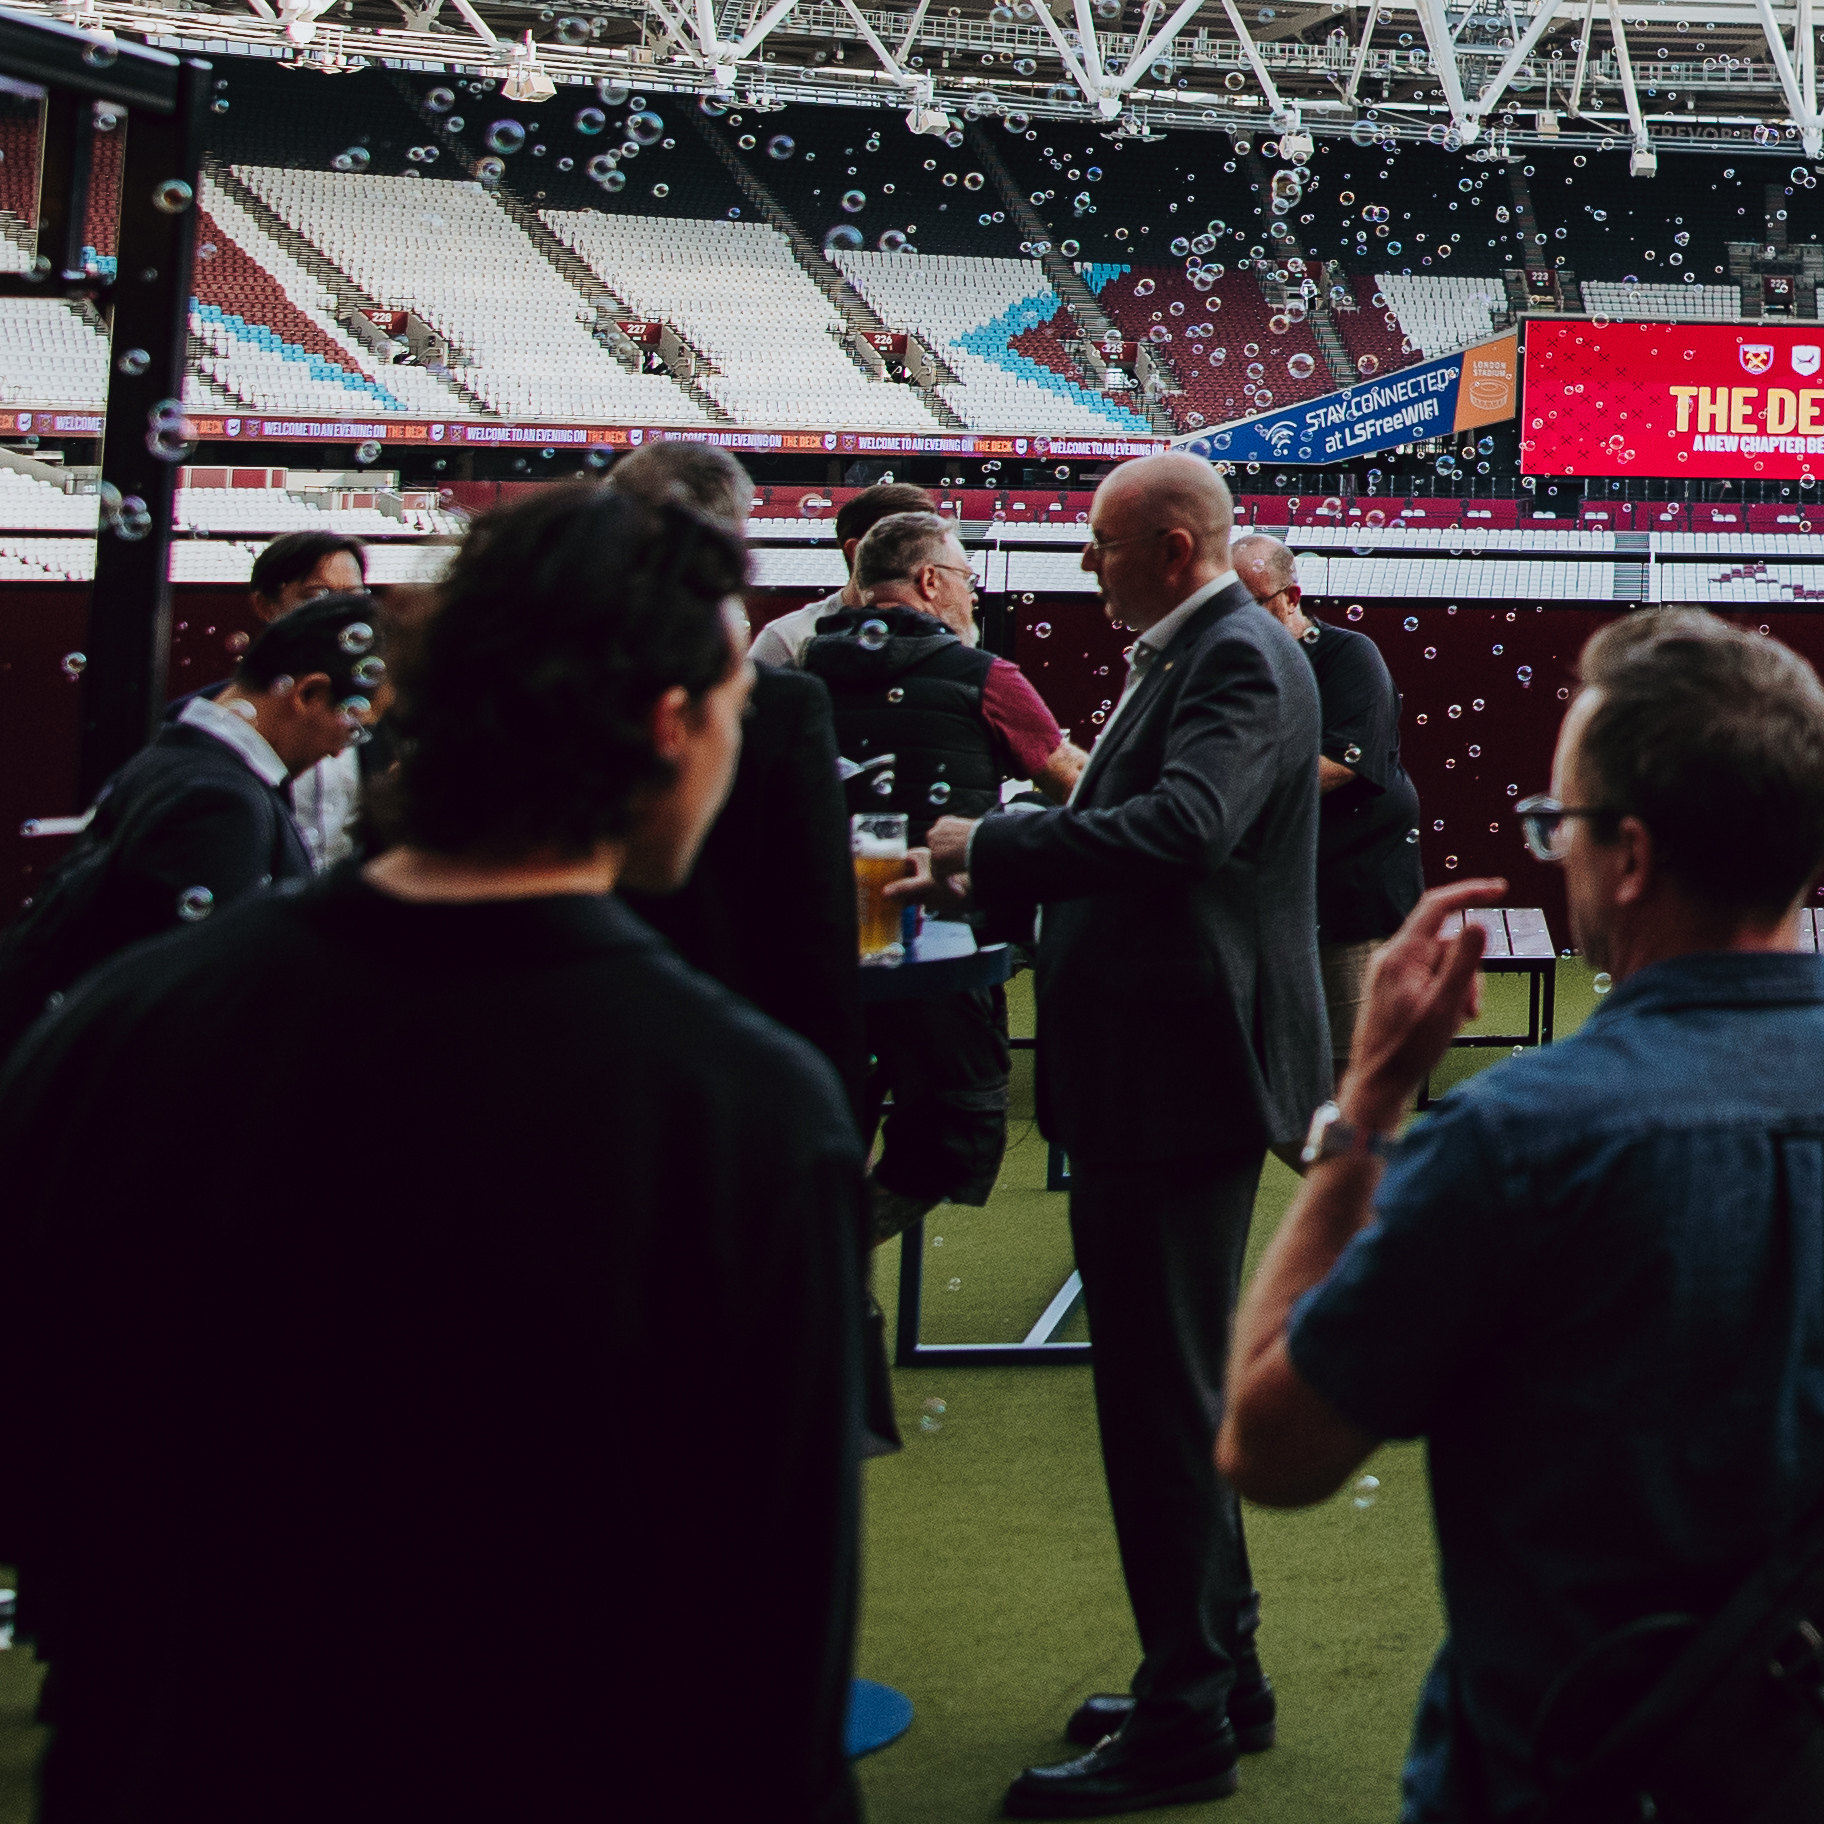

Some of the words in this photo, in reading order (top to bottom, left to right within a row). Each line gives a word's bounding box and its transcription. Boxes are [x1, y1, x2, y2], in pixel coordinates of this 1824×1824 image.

[1531, 272, 1549, 281] 223
[371, 312, 393, 323] 228
[627, 324, 647, 334] 227
[873, 334, 893, 344] 226
[1473, 361, 1507, 370] LONDON
[1473, 369, 1507, 377] STADIUM
[1306, 401, 1347, 433] STAY
[1351, 368, 1450, 416] CONNECTED
[1669, 386, 1759, 434] THE
[55, 416, 102, 431] WELCOME
[200, 419, 223, 434] DECK
[263, 422, 309, 436] WELCOME
[309, 423, 320, 436] TO
[321, 424, 334, 437] AN
[334, 424, 373, 438] EVENING
[374, 425, 387, 438] ON
[388, 425, 403, 438] THE
[405, 426, 427, 439] DECK
[466, 427, 511, 441] WELCOME
[512, 428, 523, 441] TO
[523, 429, 535, 442] AN
[536, 429, 573, 443] EVENING
[574, 430, 587, 443] ON
[588, 430, 603, 443] THE
[605, 431, 627, 444] DECK
[720, 434, 731, 446] AN
[732, 434, 770, 447] EVENING
[771, 435, 782, 448] ON
[783, 435, 798, 448] THE
[800, 436, 821, 449] DECK
[1325, 431, 1342, 453] at
[858, 437, 901, 450] WELCOME
[901, 438, 911, 450] TO
[912, 438, 924, 451] AN
[925, 438, 960, 452] EVENING
[961, 439, 974, 452] ON
[975, 440, 990, 453] THE
[991, 440, 1012, 453] DECK
[1050, 441, 1091, 454] WELCOME
[1091, 442, 1102, 454] TO
[1102, 442, 1115, 455] AN
[1116, 443, 1151, 456] EVENING
[1693, 435, 1704, 452] A
[1705, 435, 1739, 453] NEW
[1740, 436, 1806, 454] CHAPTER
